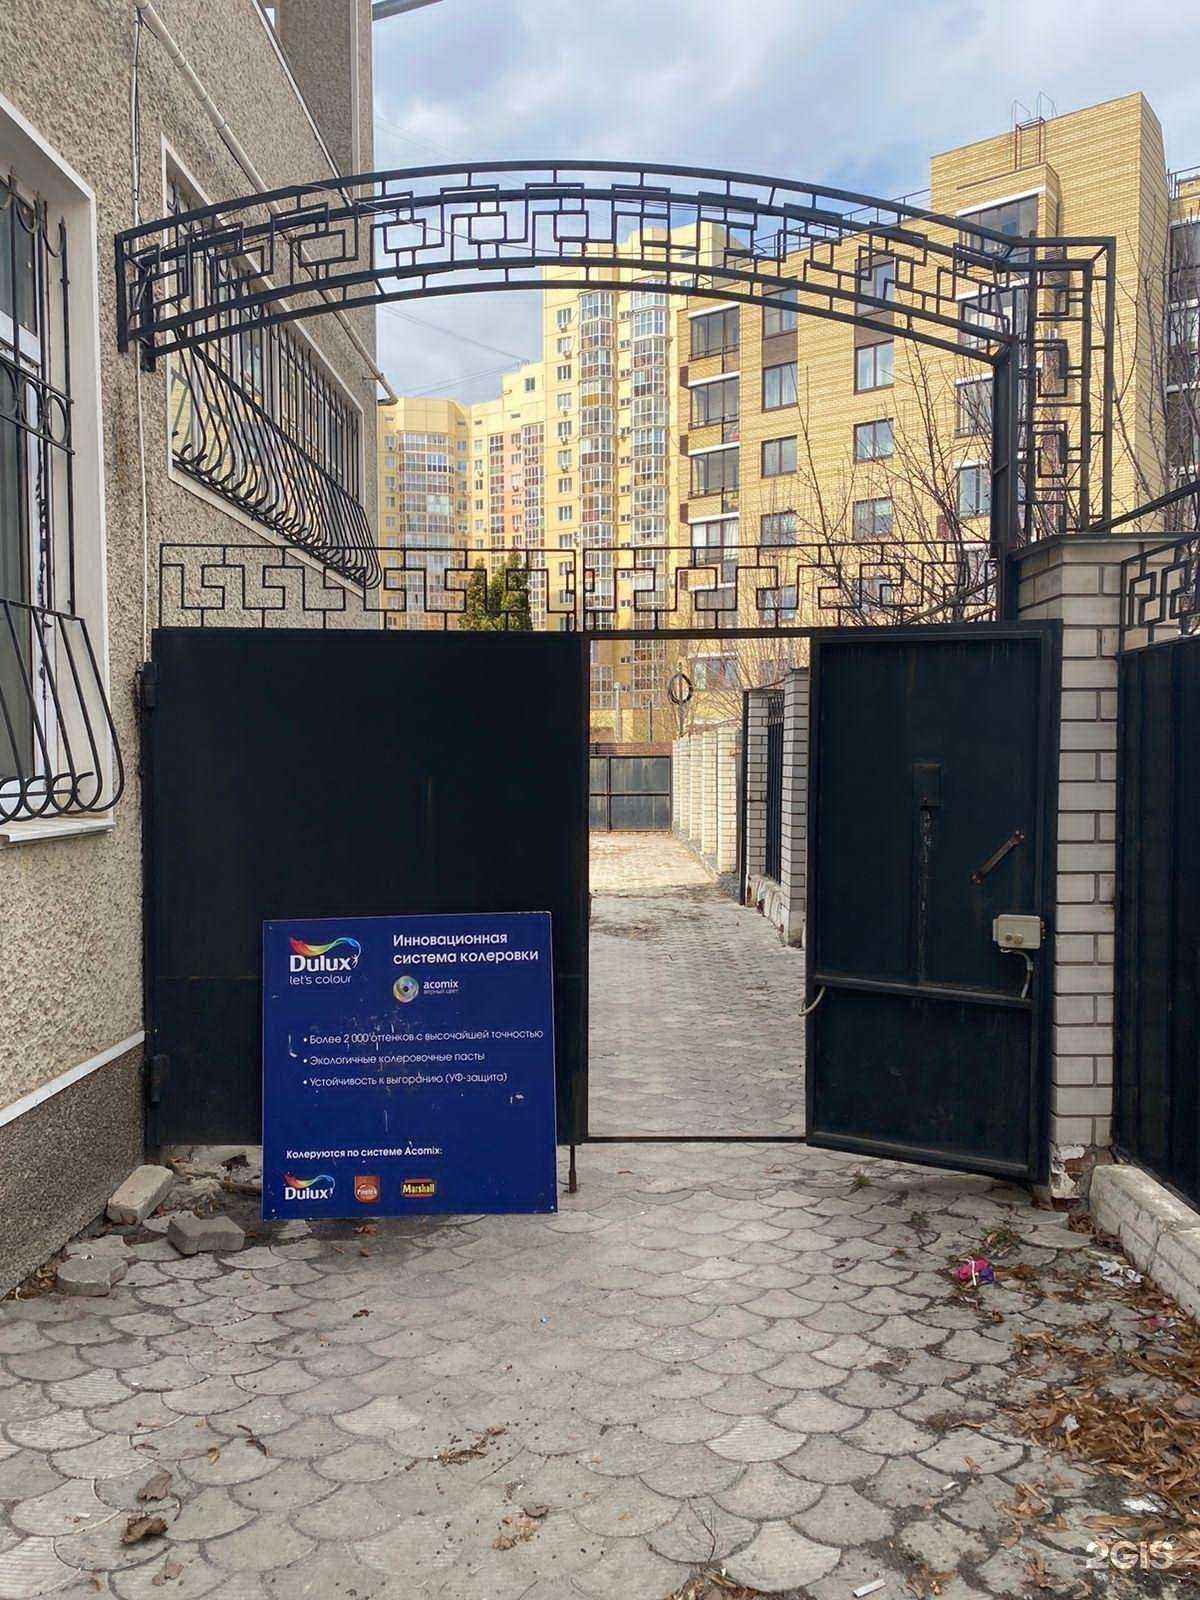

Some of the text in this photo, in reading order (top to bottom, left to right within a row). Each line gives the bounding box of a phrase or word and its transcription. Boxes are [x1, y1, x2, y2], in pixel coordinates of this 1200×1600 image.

[393, 934, 508, 947] Инновационная
[290, 955, 352, 972] Dulux
[393, 950, 539, 965] система колеровки
[289, 974, 352, 985] let's colour
[423, 979, 459, 989] acomix
[309, 1034, 342, 1044] Более
[370, 1032, 414, 1043] оттенков
[416, 1033, 423, 1041] с
[425, 1030, 489, 1041] высочайшей
[491, 1030, 544, 1039] точностью
[310, 1052, 485, 1066] Экологичные колеровочные пасты
[310, 1072, 508, 1087] Устойчивость к выгоранию (УФ-защита)
[286, 1146, 443, 1160] Колеруются по системе Acomix:
[284, 1186, 329, 1200] Dulux
[402, 1183, 435, 1194] Marshall
